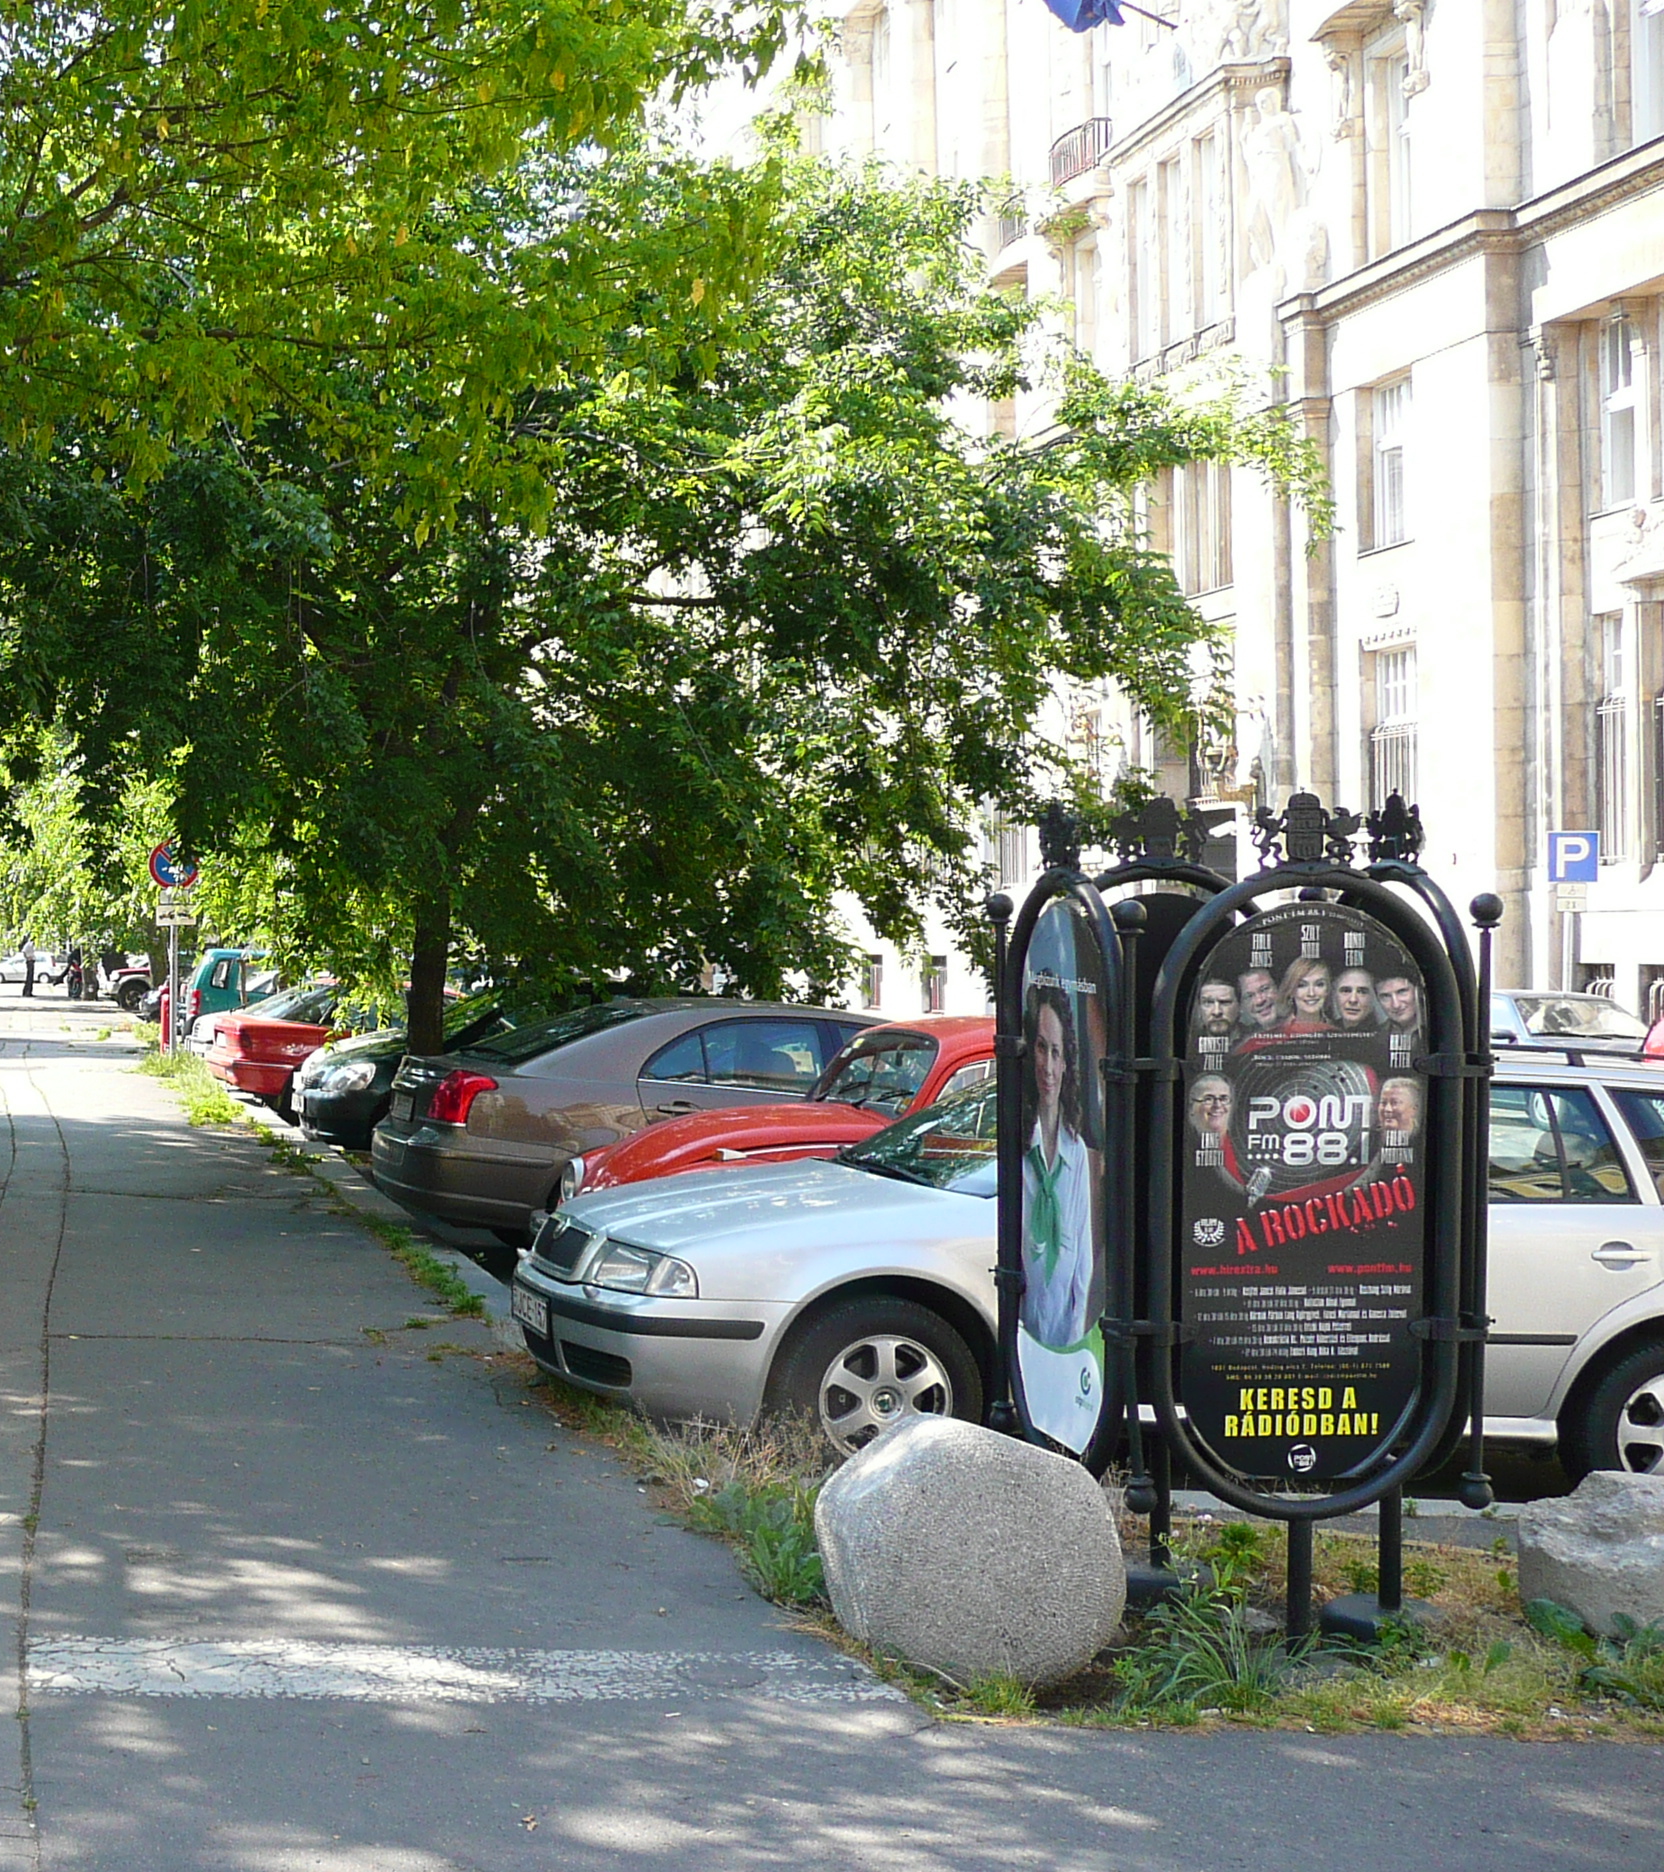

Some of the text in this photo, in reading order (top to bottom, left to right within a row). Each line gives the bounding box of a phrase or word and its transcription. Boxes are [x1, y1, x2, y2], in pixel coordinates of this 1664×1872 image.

[1556, 836, 1590, 878] P
[1300, 924, 1321, 941] SZILY
[1249, 1094, 1374, 1130] PONT
[1248, 1131, 1370, 1166] FM 88.1
[1236, 1163, 1416, 1255] A ROCKADÓ
[1239, 1387, 1357, 1410] KERESD A
[1224, 1411, 1379, 1437] RÁDIÓDBAN!
